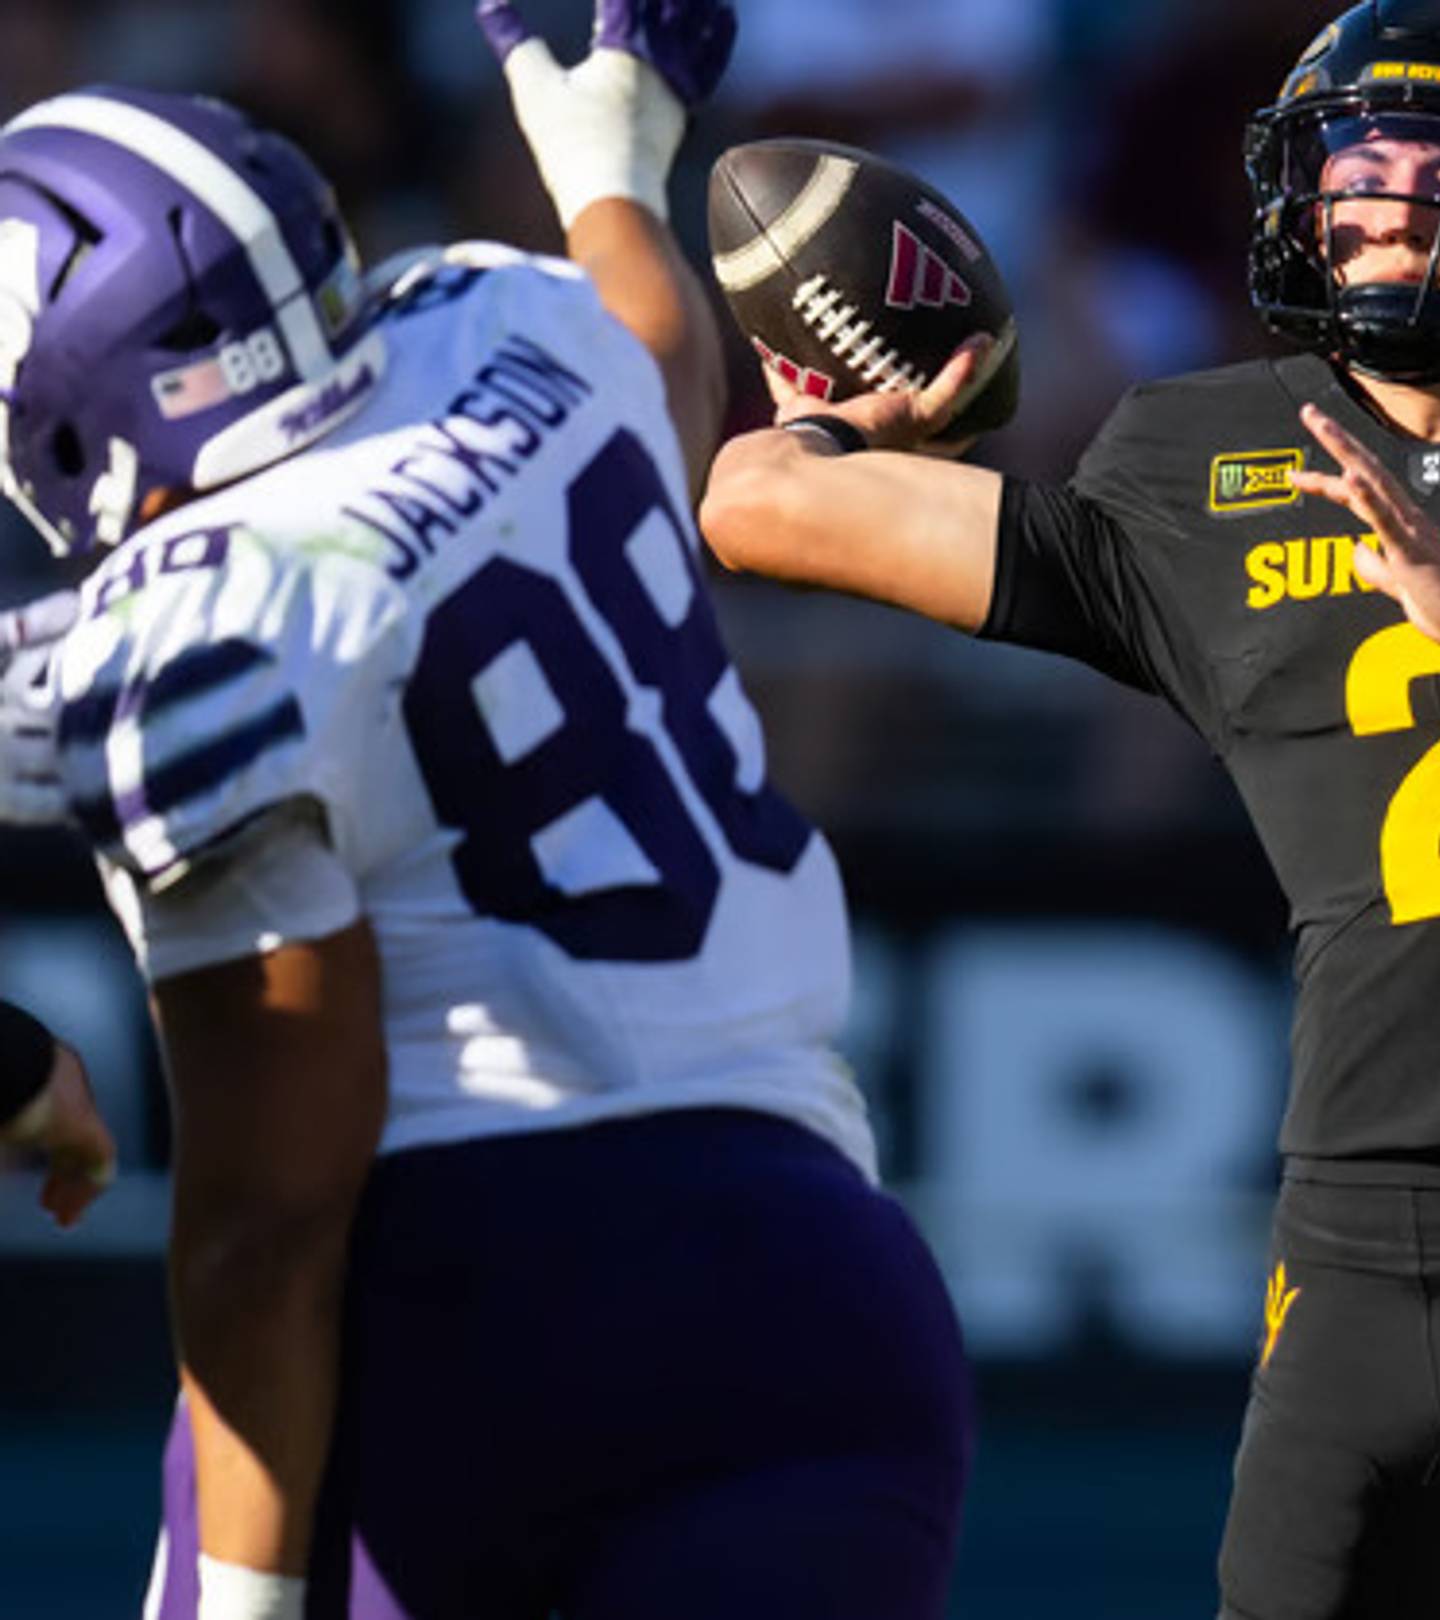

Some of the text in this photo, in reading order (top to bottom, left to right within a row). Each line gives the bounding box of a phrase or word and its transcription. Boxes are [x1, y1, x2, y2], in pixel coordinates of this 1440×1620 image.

[219, 327, 284, 393] 88
[339, 334, 593, 582] JACKSON
[1244, 534, 1384, 609] SUN
[402, 424, 816, 966] 88
